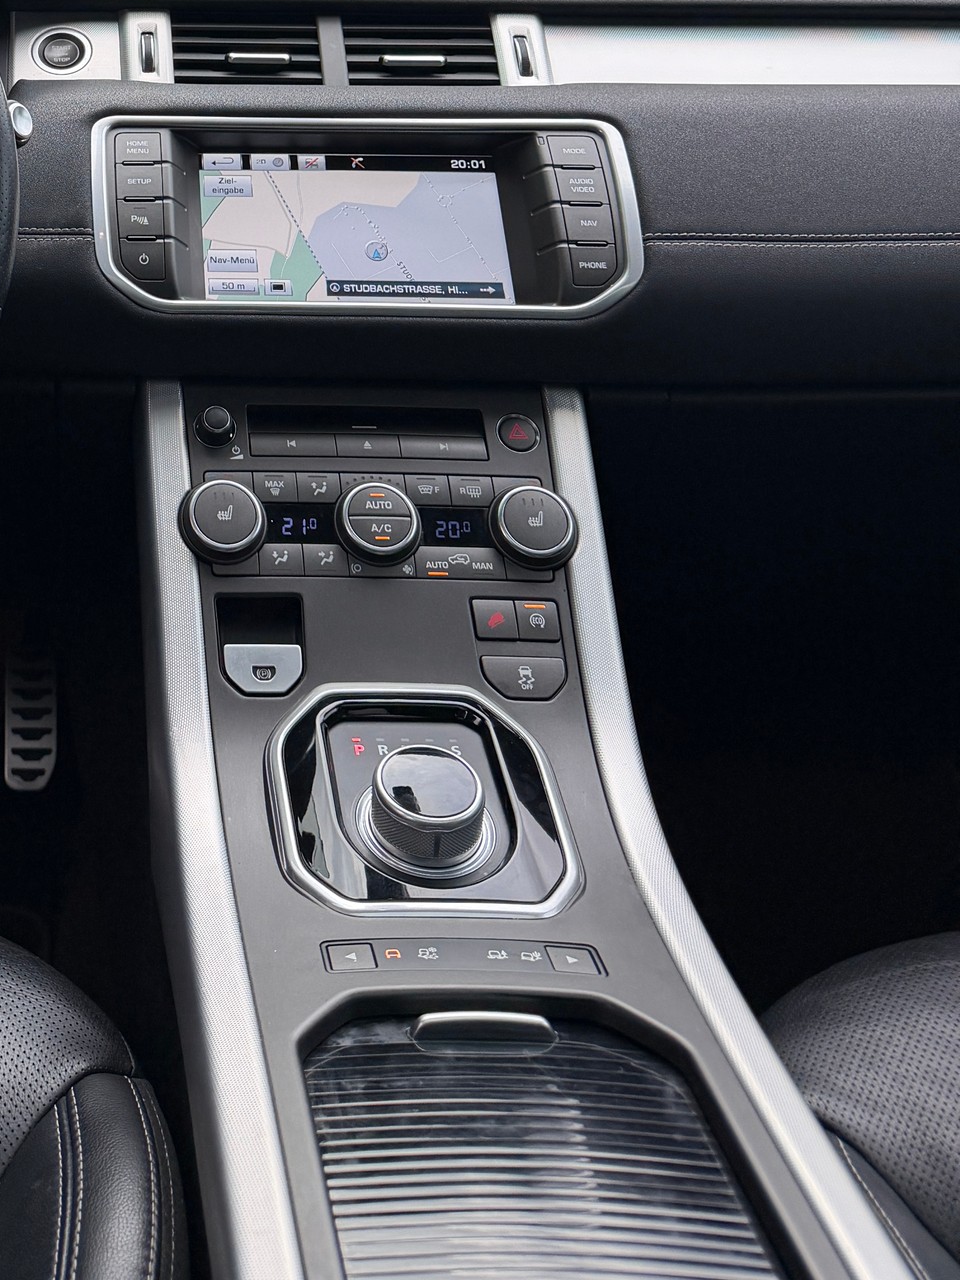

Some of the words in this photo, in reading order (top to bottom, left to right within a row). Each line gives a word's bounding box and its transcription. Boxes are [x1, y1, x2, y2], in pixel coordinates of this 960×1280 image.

[450, 160, 486, 169] 20:01
[218, 177, 237, 185] Ziel-
[212, 186, 244, 195] eingabe
[209, 256, 255, 264] Nav-Menü
[579, 261, 607, 269] PHONE
[343, 284, 445, 295] STUDBACHSTRASSE,
[448, 286, 468, 294] HI...
[264, 480, 285, 488] MAX
[365, 499, 392, 510] AUTO
[281, 517, 317, 535] 21.0
[371, 523, 392, 534] A/C
[435, 520, 471, 538] 20.0
[425, 561, 449, 569] AUTO
[472, 562, 494, 570] MAN
[532, 616, 542, 624] ECO
[353, 744, 365, 756] P
[377, 745, 389, 755] R
[450, 745, 462, 756] S
